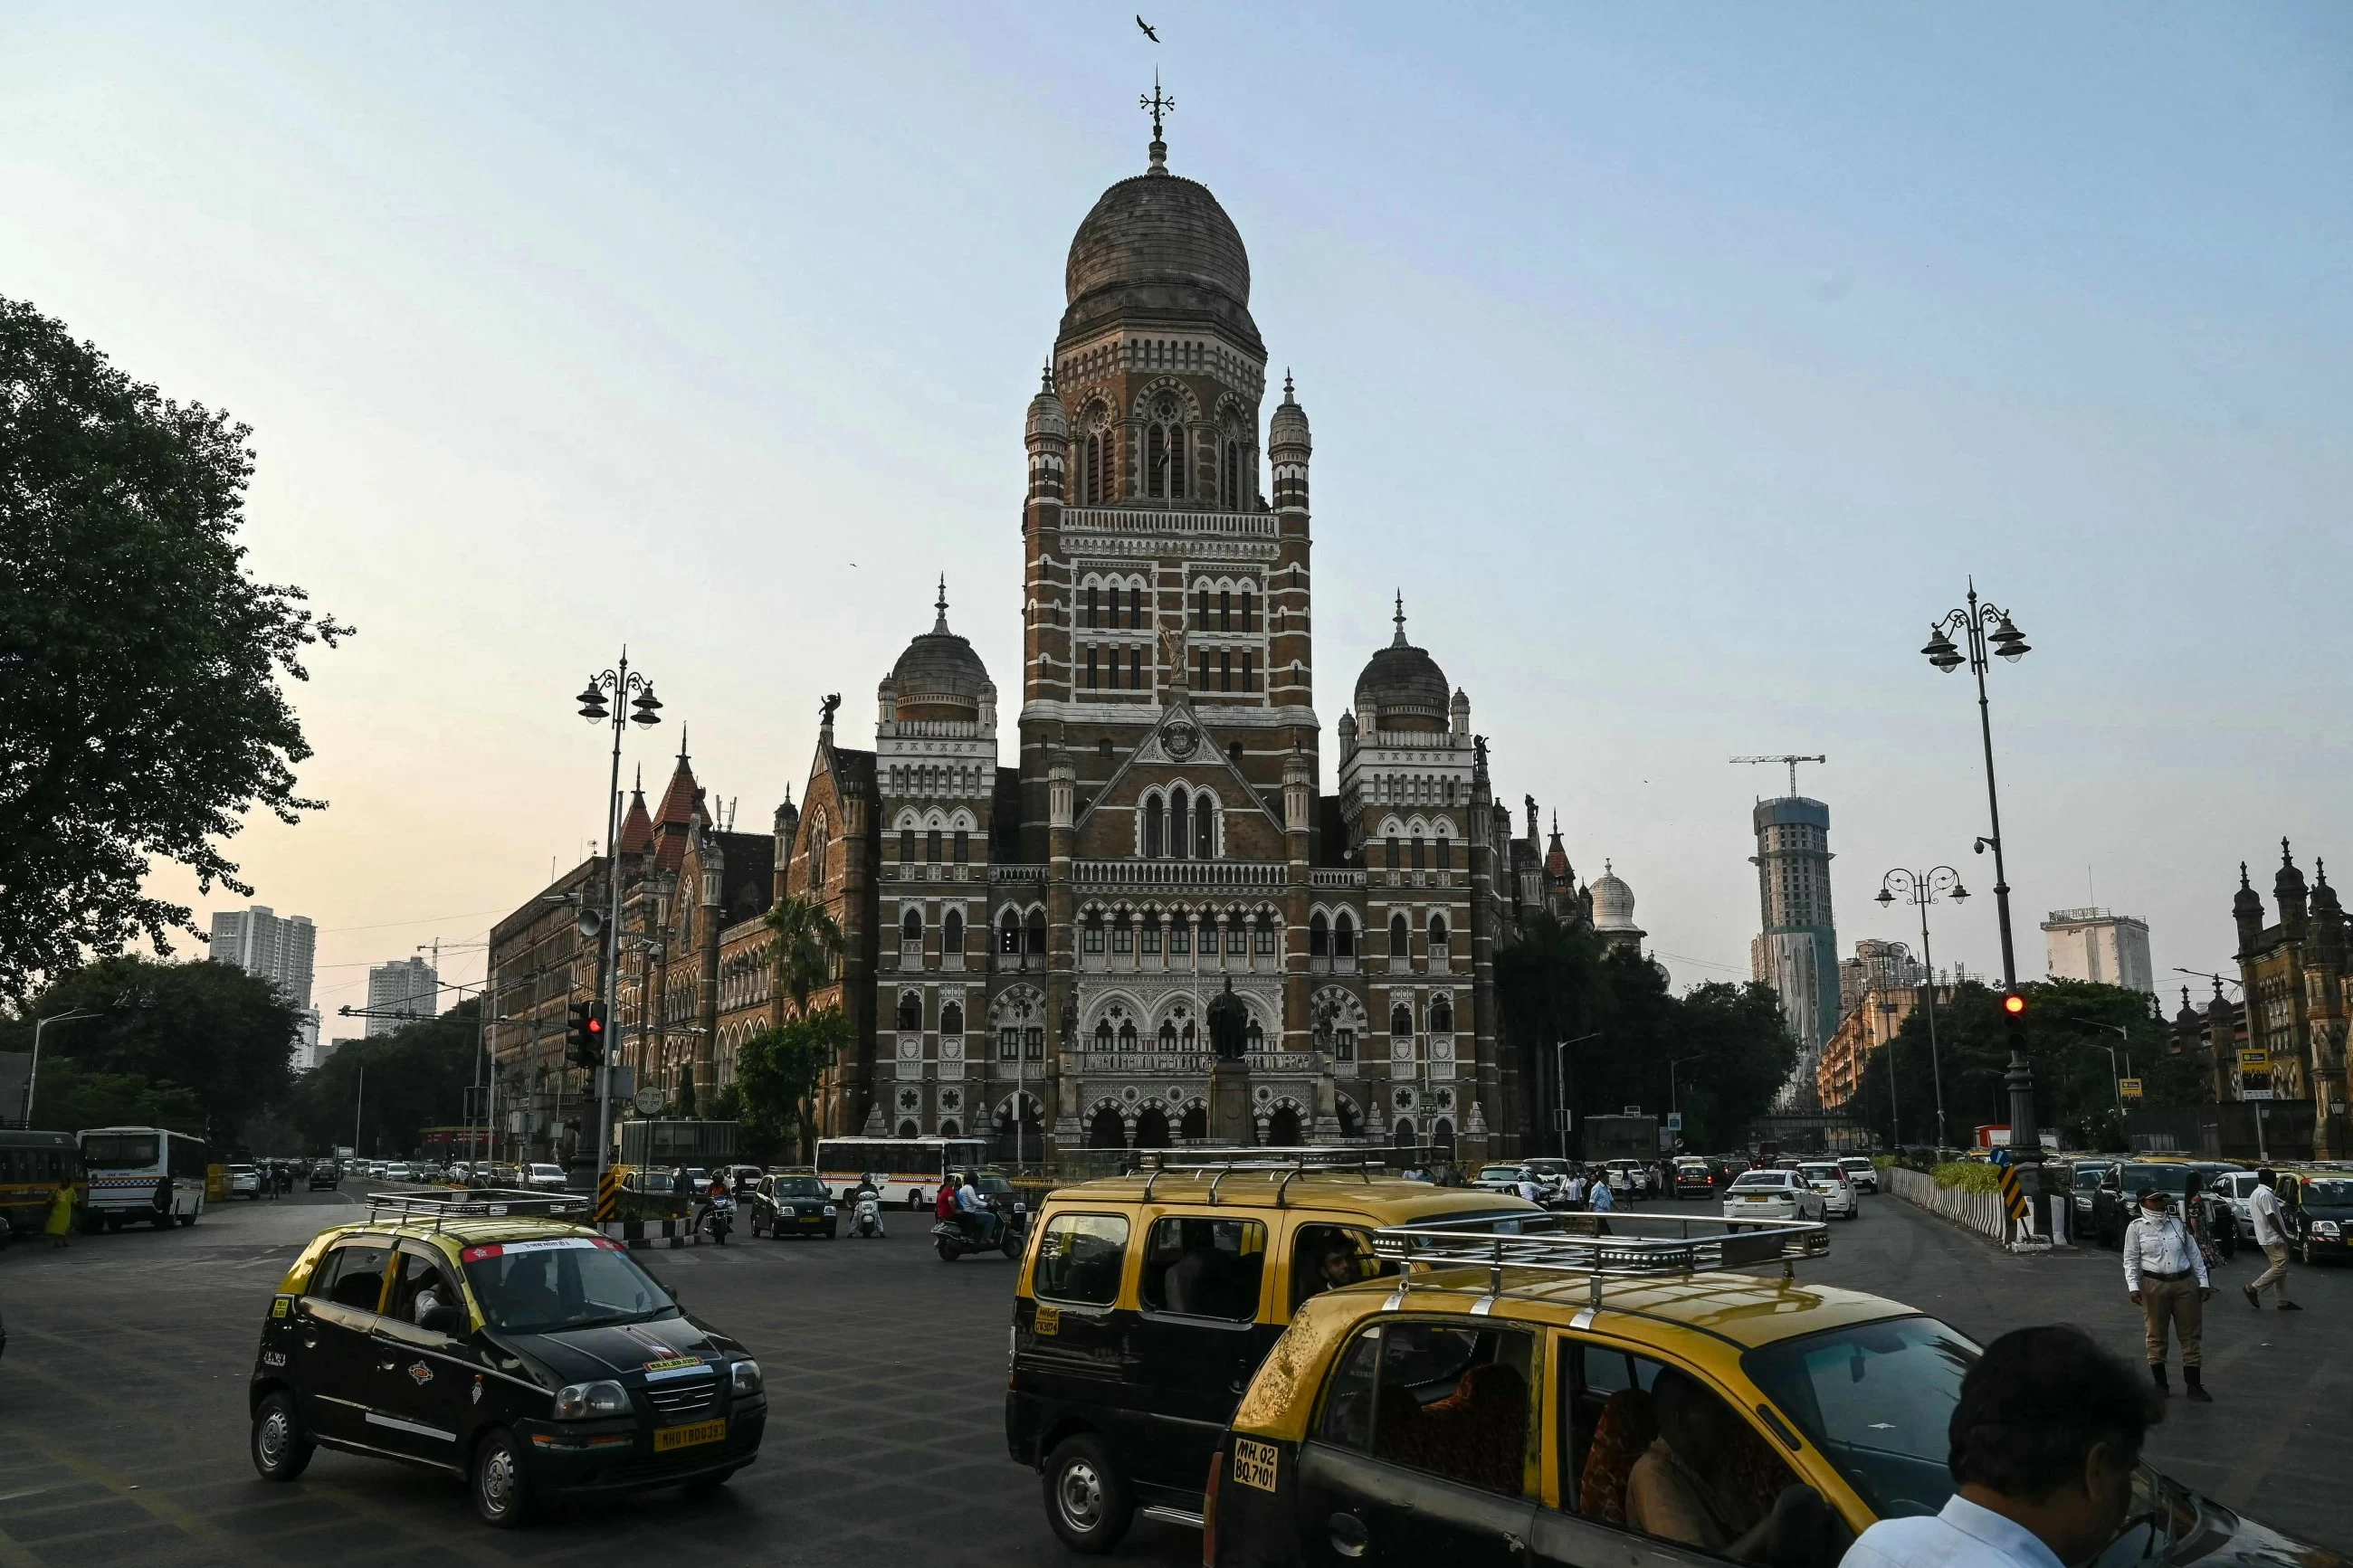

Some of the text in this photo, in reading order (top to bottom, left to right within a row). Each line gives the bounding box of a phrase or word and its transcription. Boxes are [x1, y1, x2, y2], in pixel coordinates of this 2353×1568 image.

[662, 1423, 724, 1446] MH01BD0393
[1260, 1447, 1275, 1466] 02
[1235, 1459, 1273, 1488] BQ.7101
